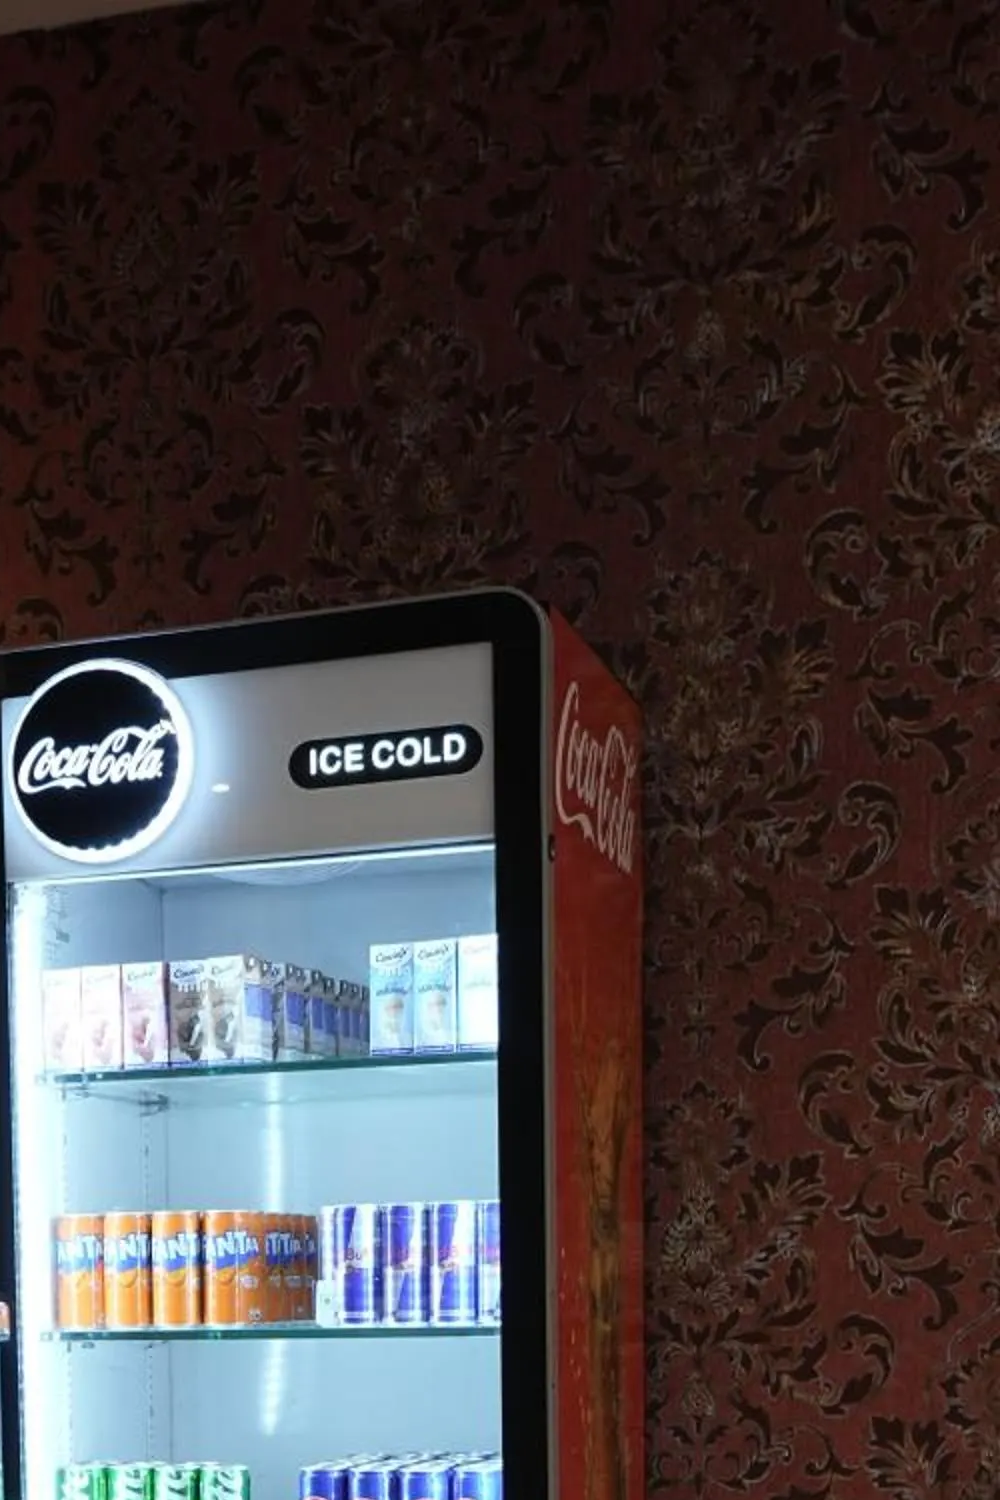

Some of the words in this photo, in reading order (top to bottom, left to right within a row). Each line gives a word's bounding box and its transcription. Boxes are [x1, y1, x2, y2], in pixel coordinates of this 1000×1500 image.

[18, 719, 175, 794] Coca-Cola
[309, 743, 365, 776] ICE
[371, 732, 467, 769] COLD
